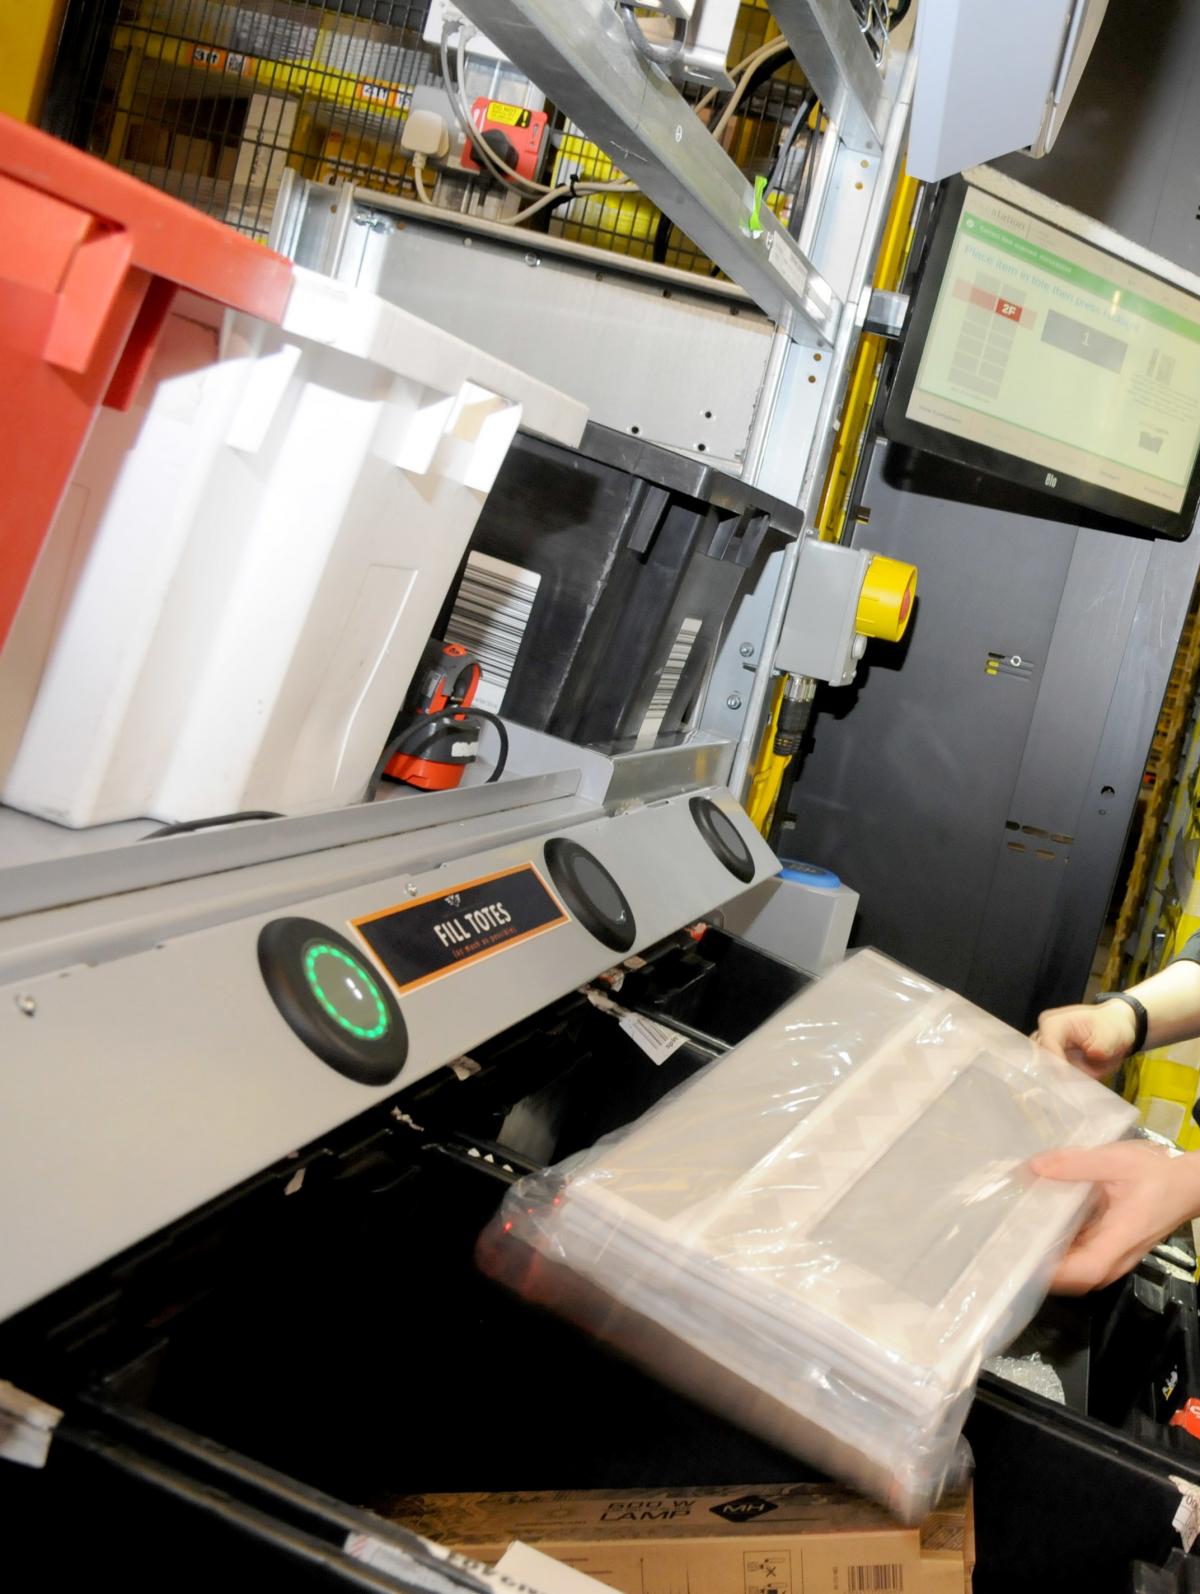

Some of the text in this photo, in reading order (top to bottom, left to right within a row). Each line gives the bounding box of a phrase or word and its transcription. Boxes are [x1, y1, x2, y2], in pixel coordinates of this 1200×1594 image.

[1001, 303, 1016, 316] 2F
[433, 902, 512, 947] FILL TOTES
[723, 1504, 766, 1513] MH
[600, 1510, 691, 1522] LAMP
